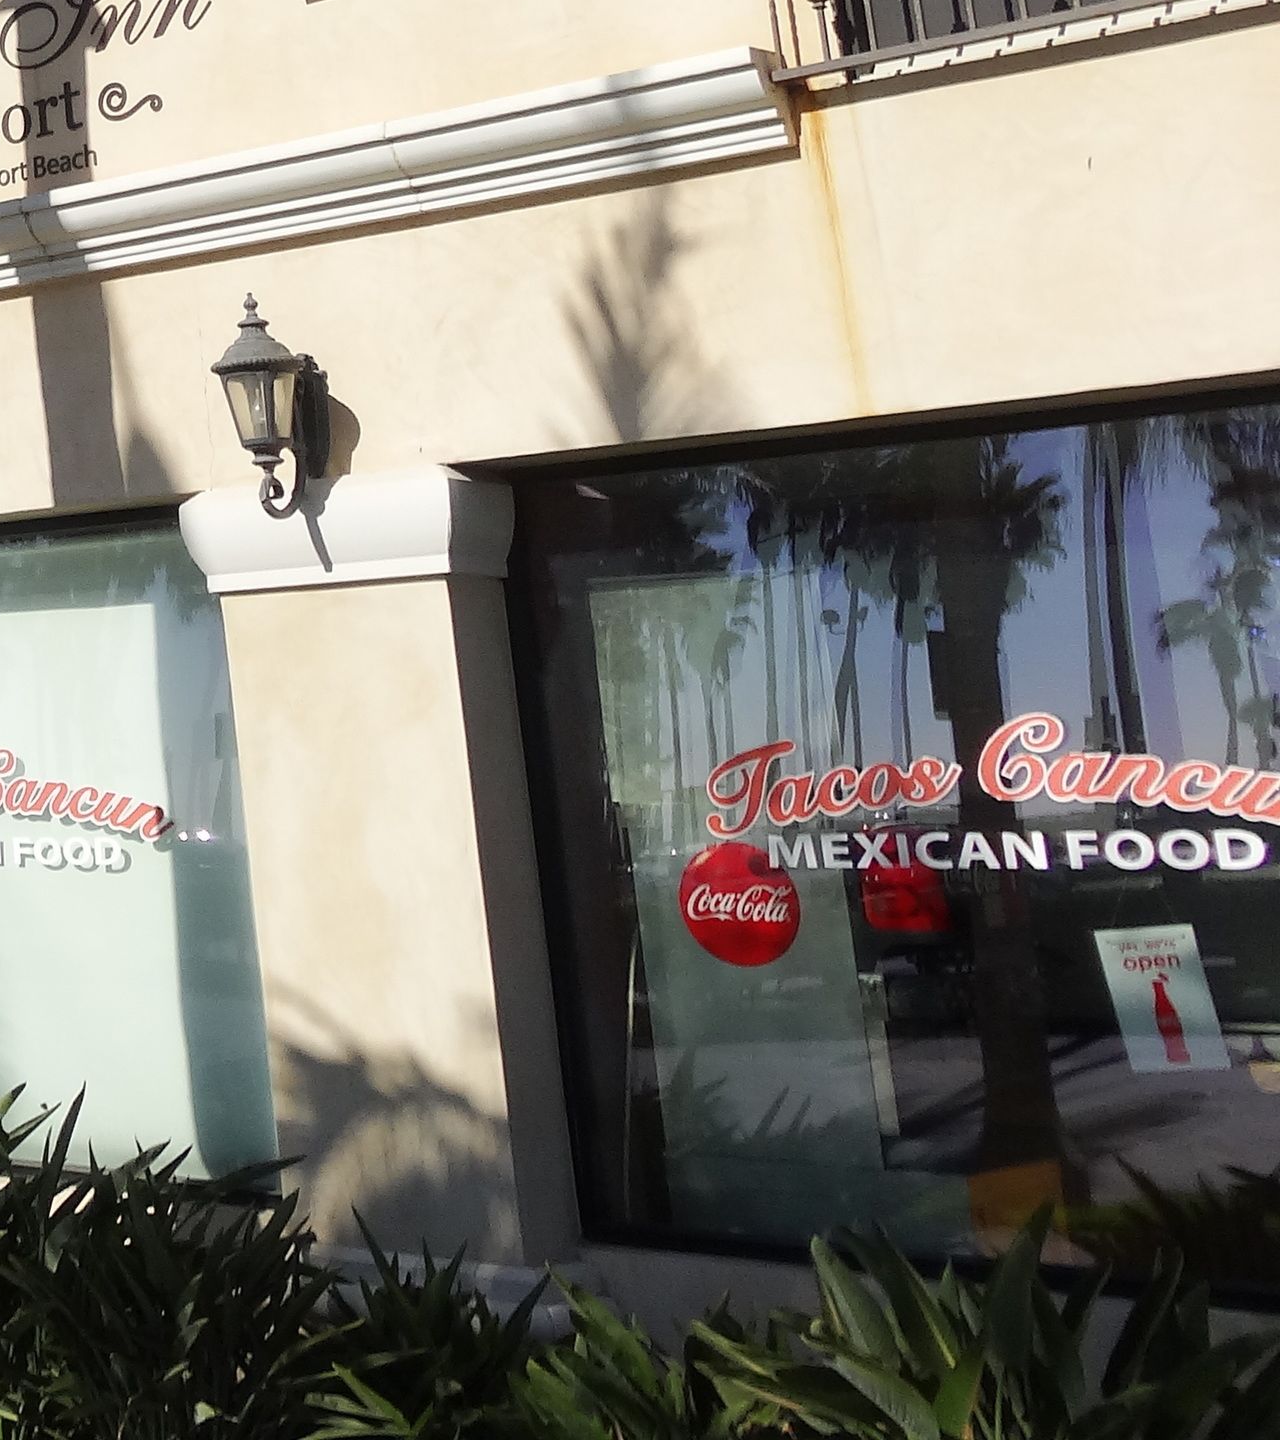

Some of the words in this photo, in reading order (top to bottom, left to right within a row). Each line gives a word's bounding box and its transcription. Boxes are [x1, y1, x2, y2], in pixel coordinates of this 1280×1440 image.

[33, 144, 98, 178] Beach
[706, 739, 962, 839] Tacos
[977, 711, 1280, 826] Cancu
[13, 835, 128, 870] FOOD
[767, 831, 1050, 870] MEXICAN
[1064, 828, 1267, 871] FOOD
[686, 883, 793, 923] Coca-Cola
[1122, 953, 1181, 974] open
